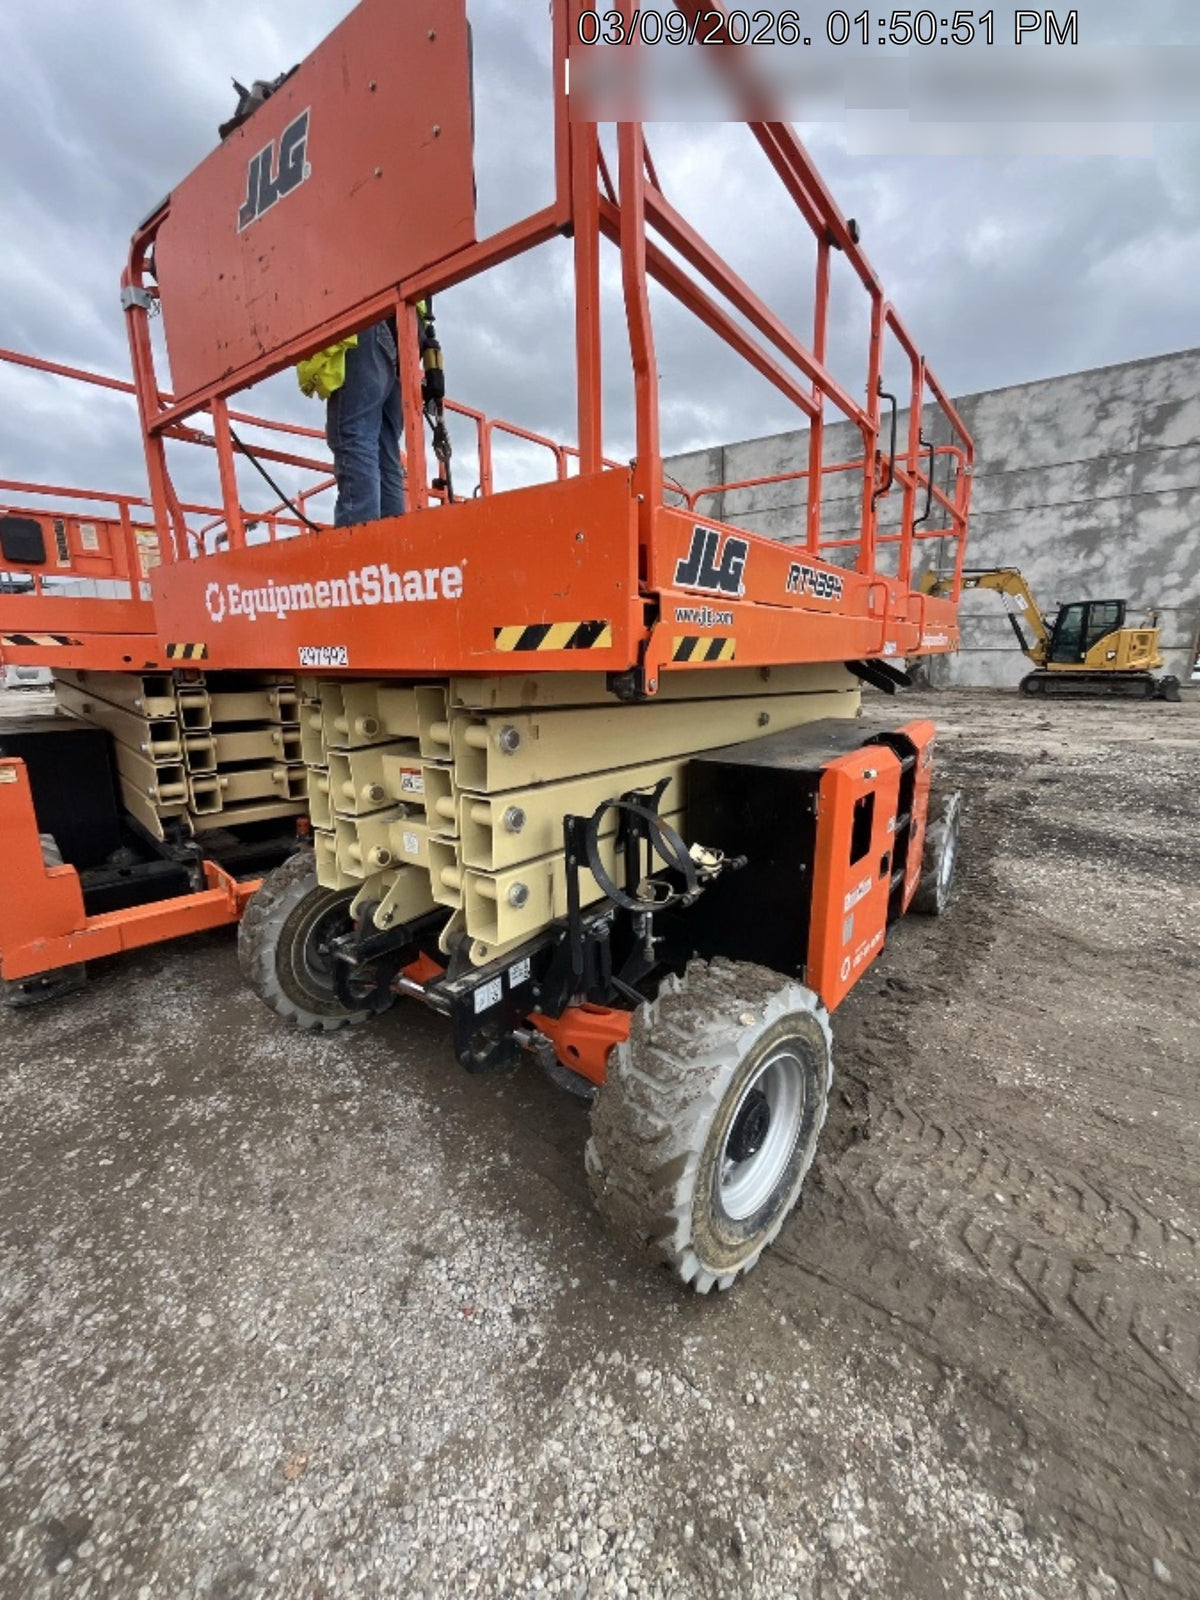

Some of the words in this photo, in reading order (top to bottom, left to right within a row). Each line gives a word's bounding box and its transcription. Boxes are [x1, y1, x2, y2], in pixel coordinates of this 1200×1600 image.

[237, 105, 311, 233] JLG
[227, 563, 464, 622] EquipmentShare
[673, 524, 749, 597] JLG
